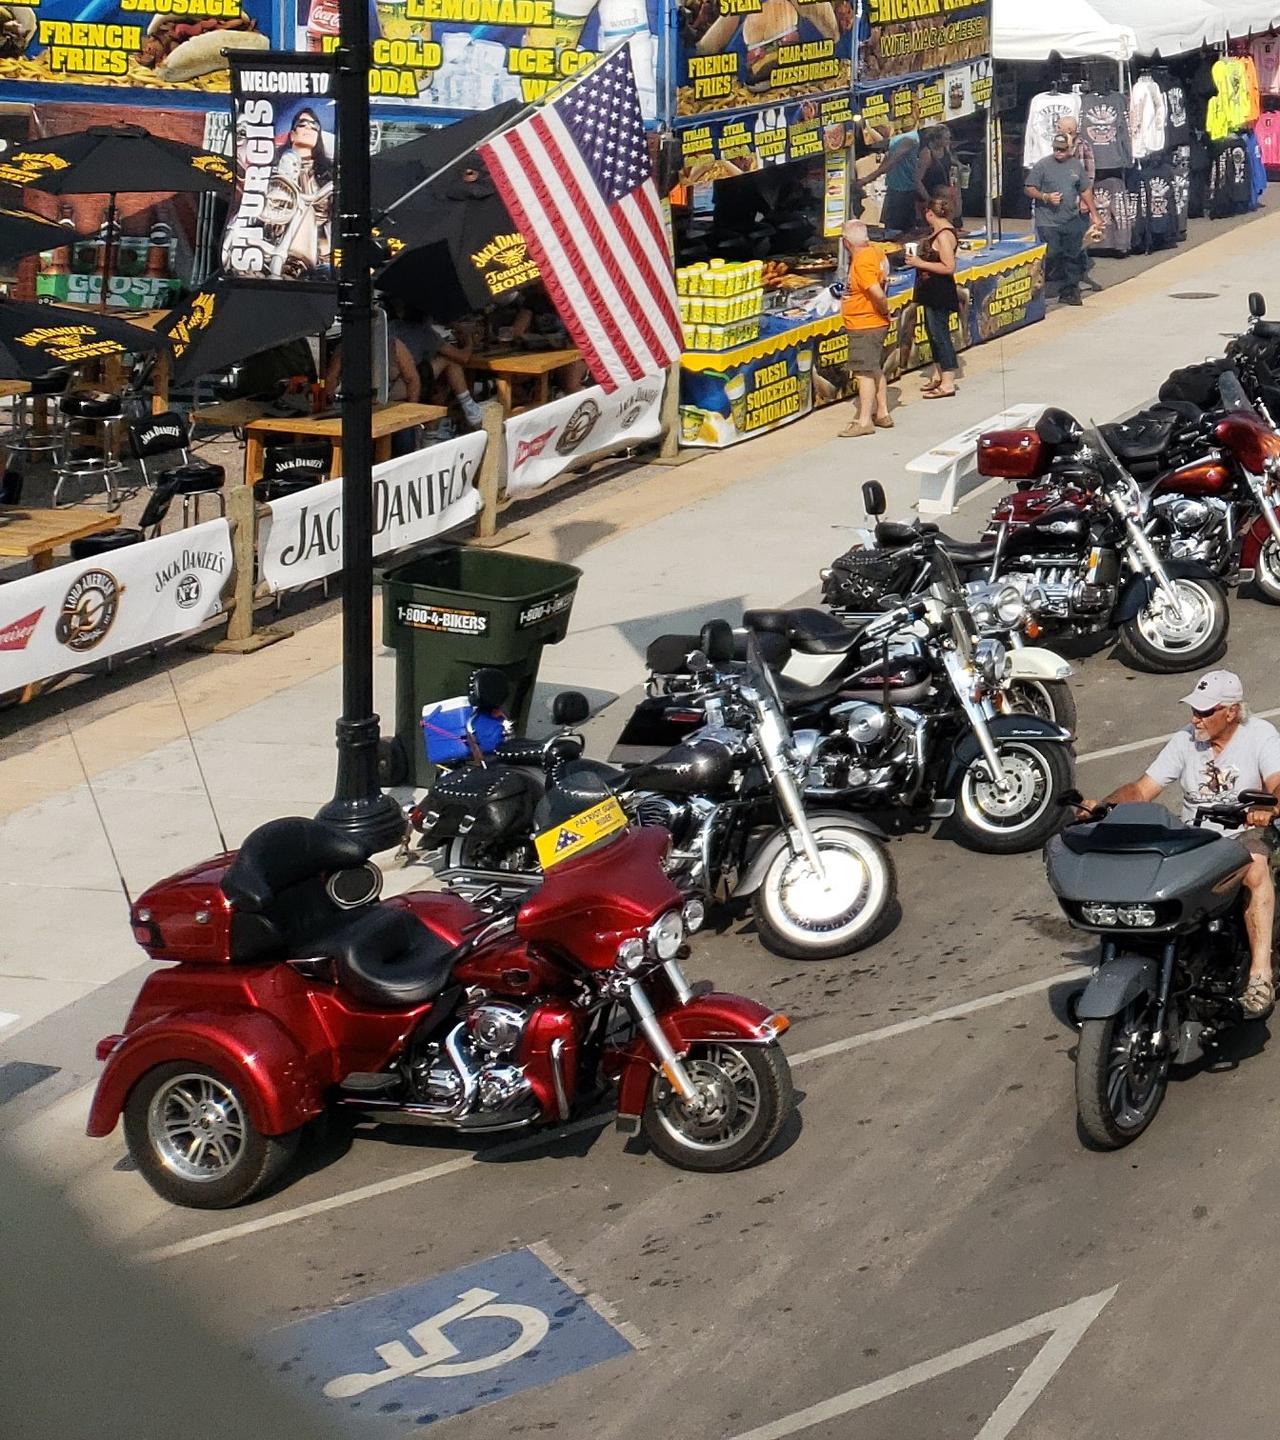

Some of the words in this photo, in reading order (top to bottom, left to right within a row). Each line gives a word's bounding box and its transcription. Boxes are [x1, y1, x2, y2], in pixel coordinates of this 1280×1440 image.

[39, 20, 142, 50] FRENCH
[880, 32, 912, 58] WITH
[912, 26, 938, 52] MAC
[948, 15, 985, 44] CHEESE
[51, 48, 129, 74] FRIES
[373, 38, 442, 69] COLD
[508, 47, 555, 75] ICE
[687, 53, 738, 79] FRENCH
[778, 39, 834, 65] CHAR-GRILLED
[240, 70, 309, 92] WELCOME
[310, 72, 330, 93] TO
[369, 70, 419, 97] ODA
[694, 74, 732, 97] FRIES
[769, 58, 841, 87] CHEESEBURGERS
[231, 98, 276, 272] STURGIS
[489, 267, 541, 295] HONE
[754, 361, 788, 388] FRESH
[746, 376, 798, 411] SQUEEZED
[745, 393, 800, 431] LEMONADE
[280, 506, 342, 567] JAC
[372, 453, 473, 536] DANIEL'S
[154, 560, 181, 593] JACK
[182, 549, 226, 575] DANIEL'S
[65, 583, 85, 610] LOUD
[397, 607, 487, 631] 1-800-4-BIKERS
